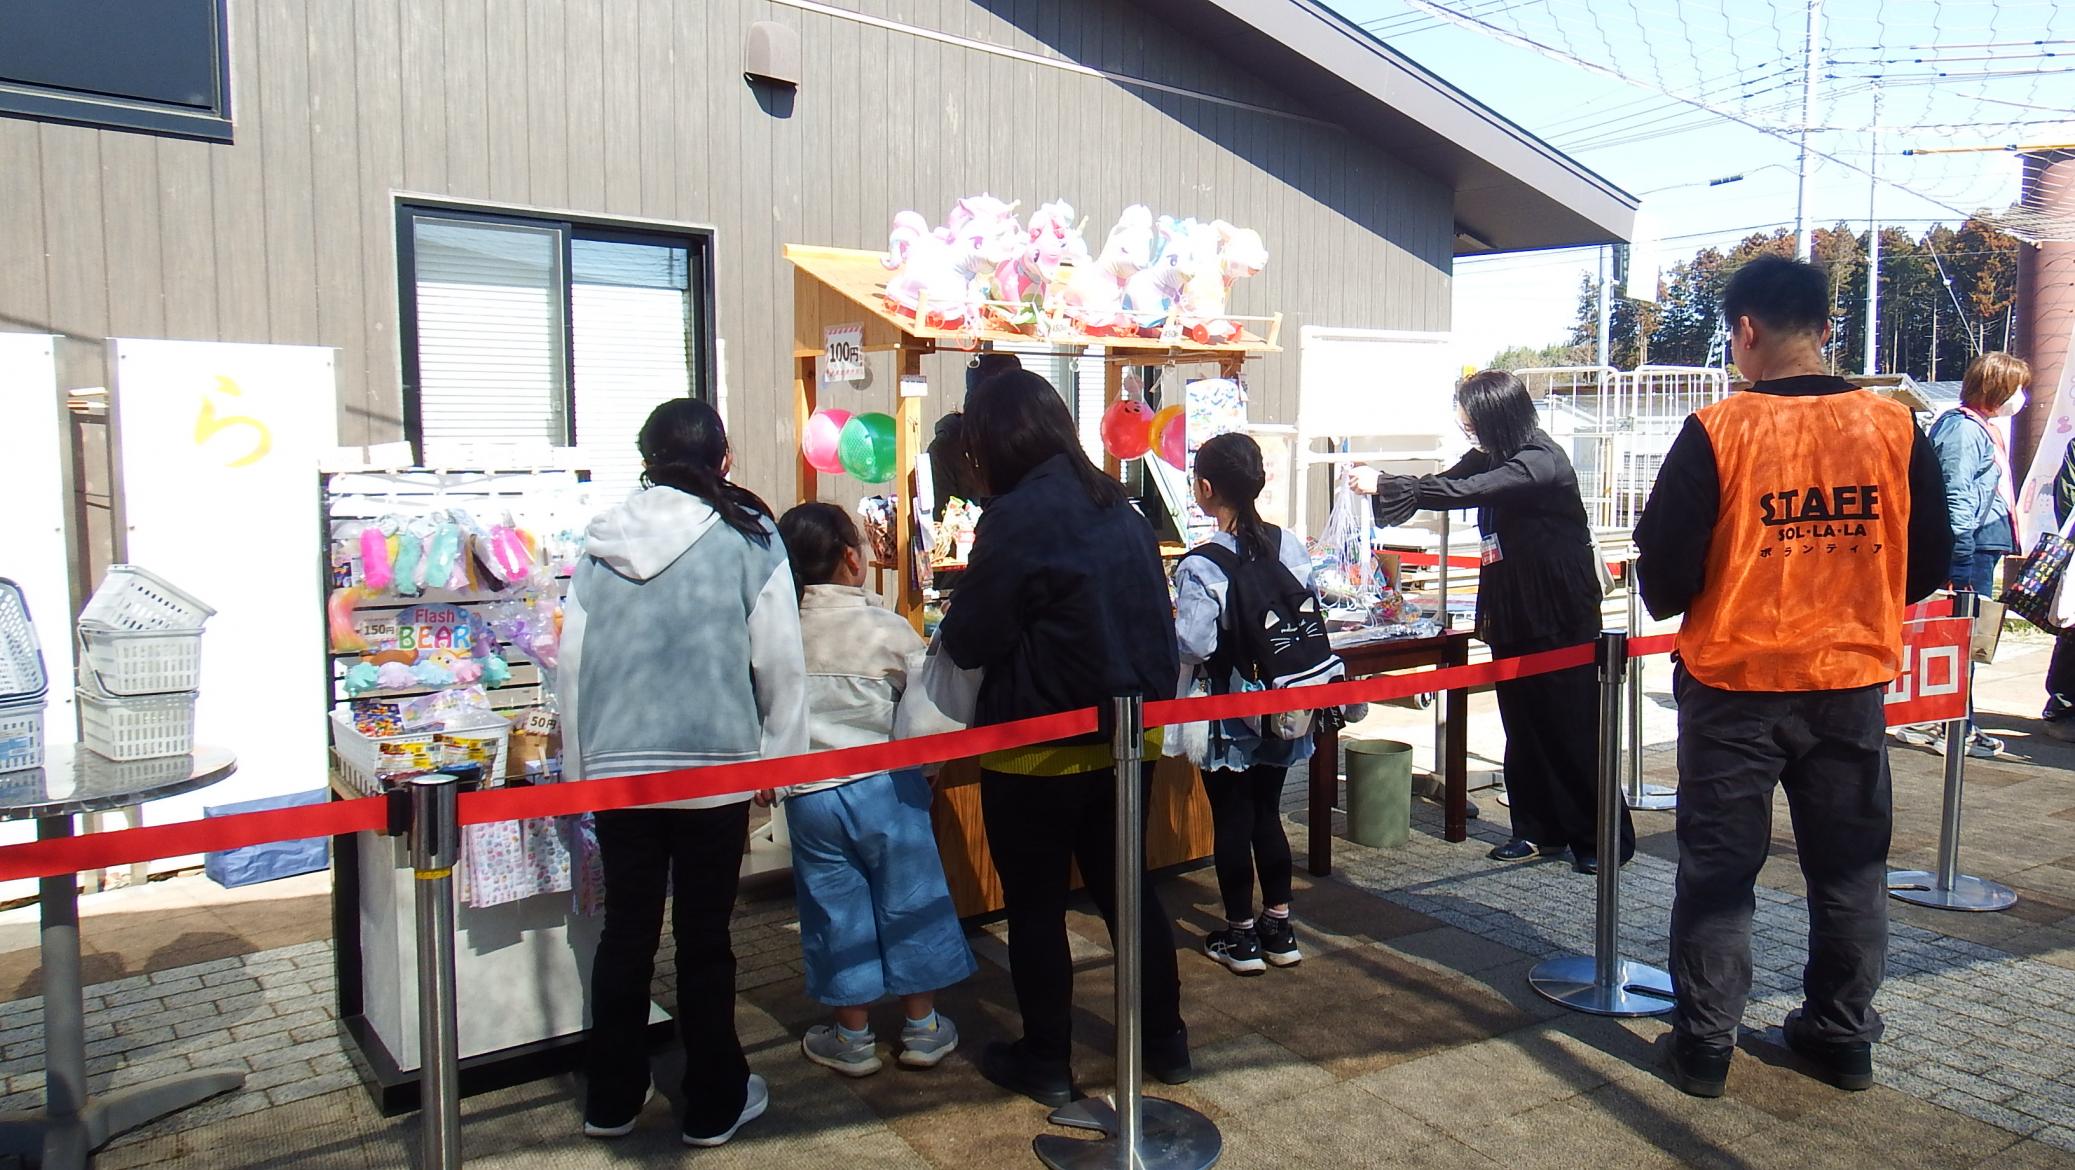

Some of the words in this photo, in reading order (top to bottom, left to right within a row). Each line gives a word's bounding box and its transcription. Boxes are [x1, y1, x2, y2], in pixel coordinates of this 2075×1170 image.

[829, 341, 859, 362] 100円
[194, 375, 273, 468] ら
[1760, 485, 1880, 526] STAFF
[1760, 543, 1882, 558] ボランティア
[415, 609, 455, 623] Flash
[364, 624, 395, 635] 150円
[399, 626, 471, 649] BEAR
[530, 716, 557, 729] 50円
